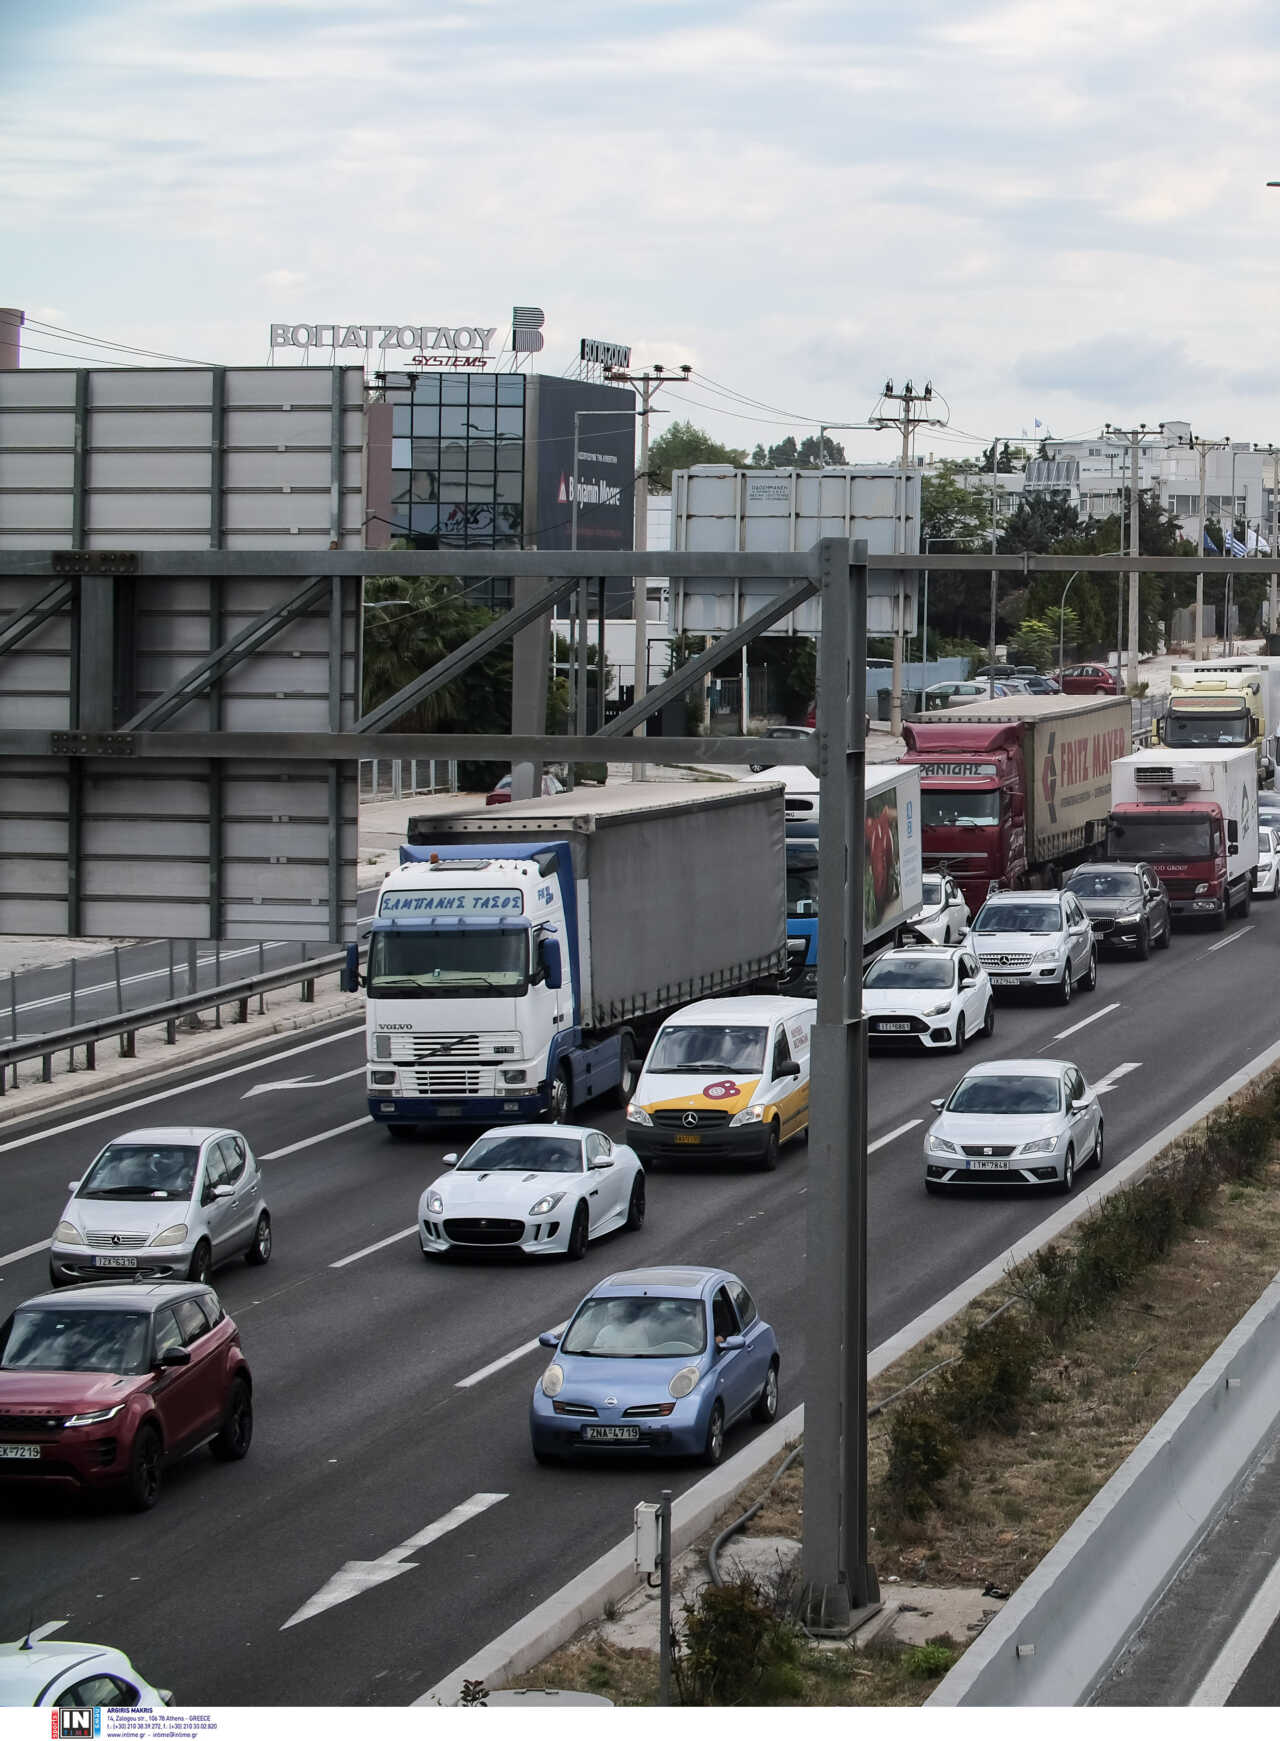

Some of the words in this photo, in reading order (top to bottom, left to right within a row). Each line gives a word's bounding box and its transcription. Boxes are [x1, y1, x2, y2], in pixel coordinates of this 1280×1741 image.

[270, 323, 497, 351] ΒΟΓΙΑΤΖΟΓΛΟΥ
[406, 355, 495, 367] SYSTEMS
[569, 476, 598, 509] Bnjamin
[1060, 738, 1088, 787] FRITZ
[382, 896, 465, 910] ΣΑΜΠΑΝΗΣ
[472, 896, 520, 909] ΤΑΣΟΣ
